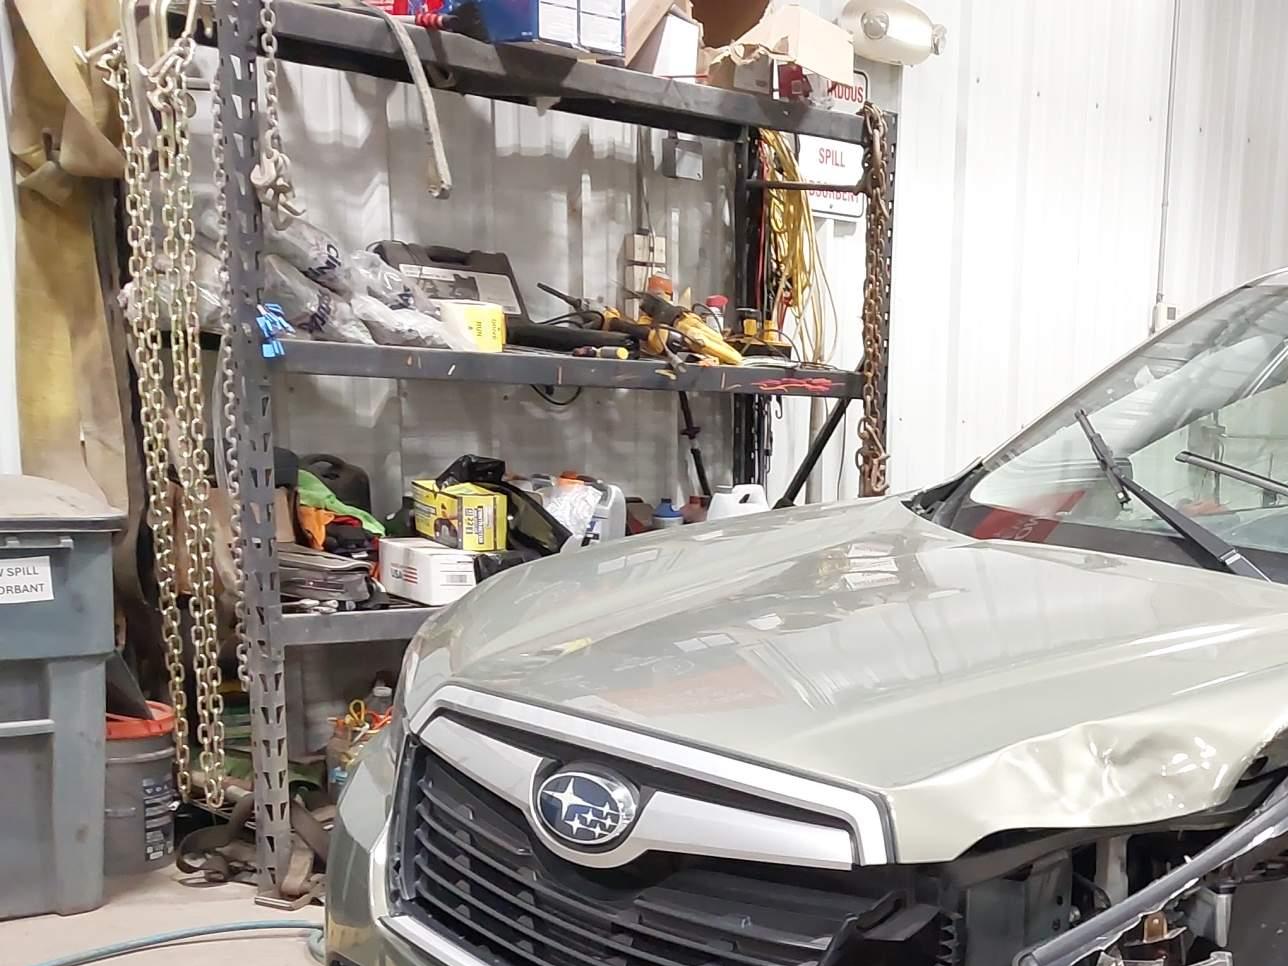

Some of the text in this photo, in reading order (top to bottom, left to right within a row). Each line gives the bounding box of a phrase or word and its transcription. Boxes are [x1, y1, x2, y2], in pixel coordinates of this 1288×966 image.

[818, 147, 846, 168] SPILL
[7, 566, 39, 577] SPILL
[0, 583, 45, 595] ORBANT
